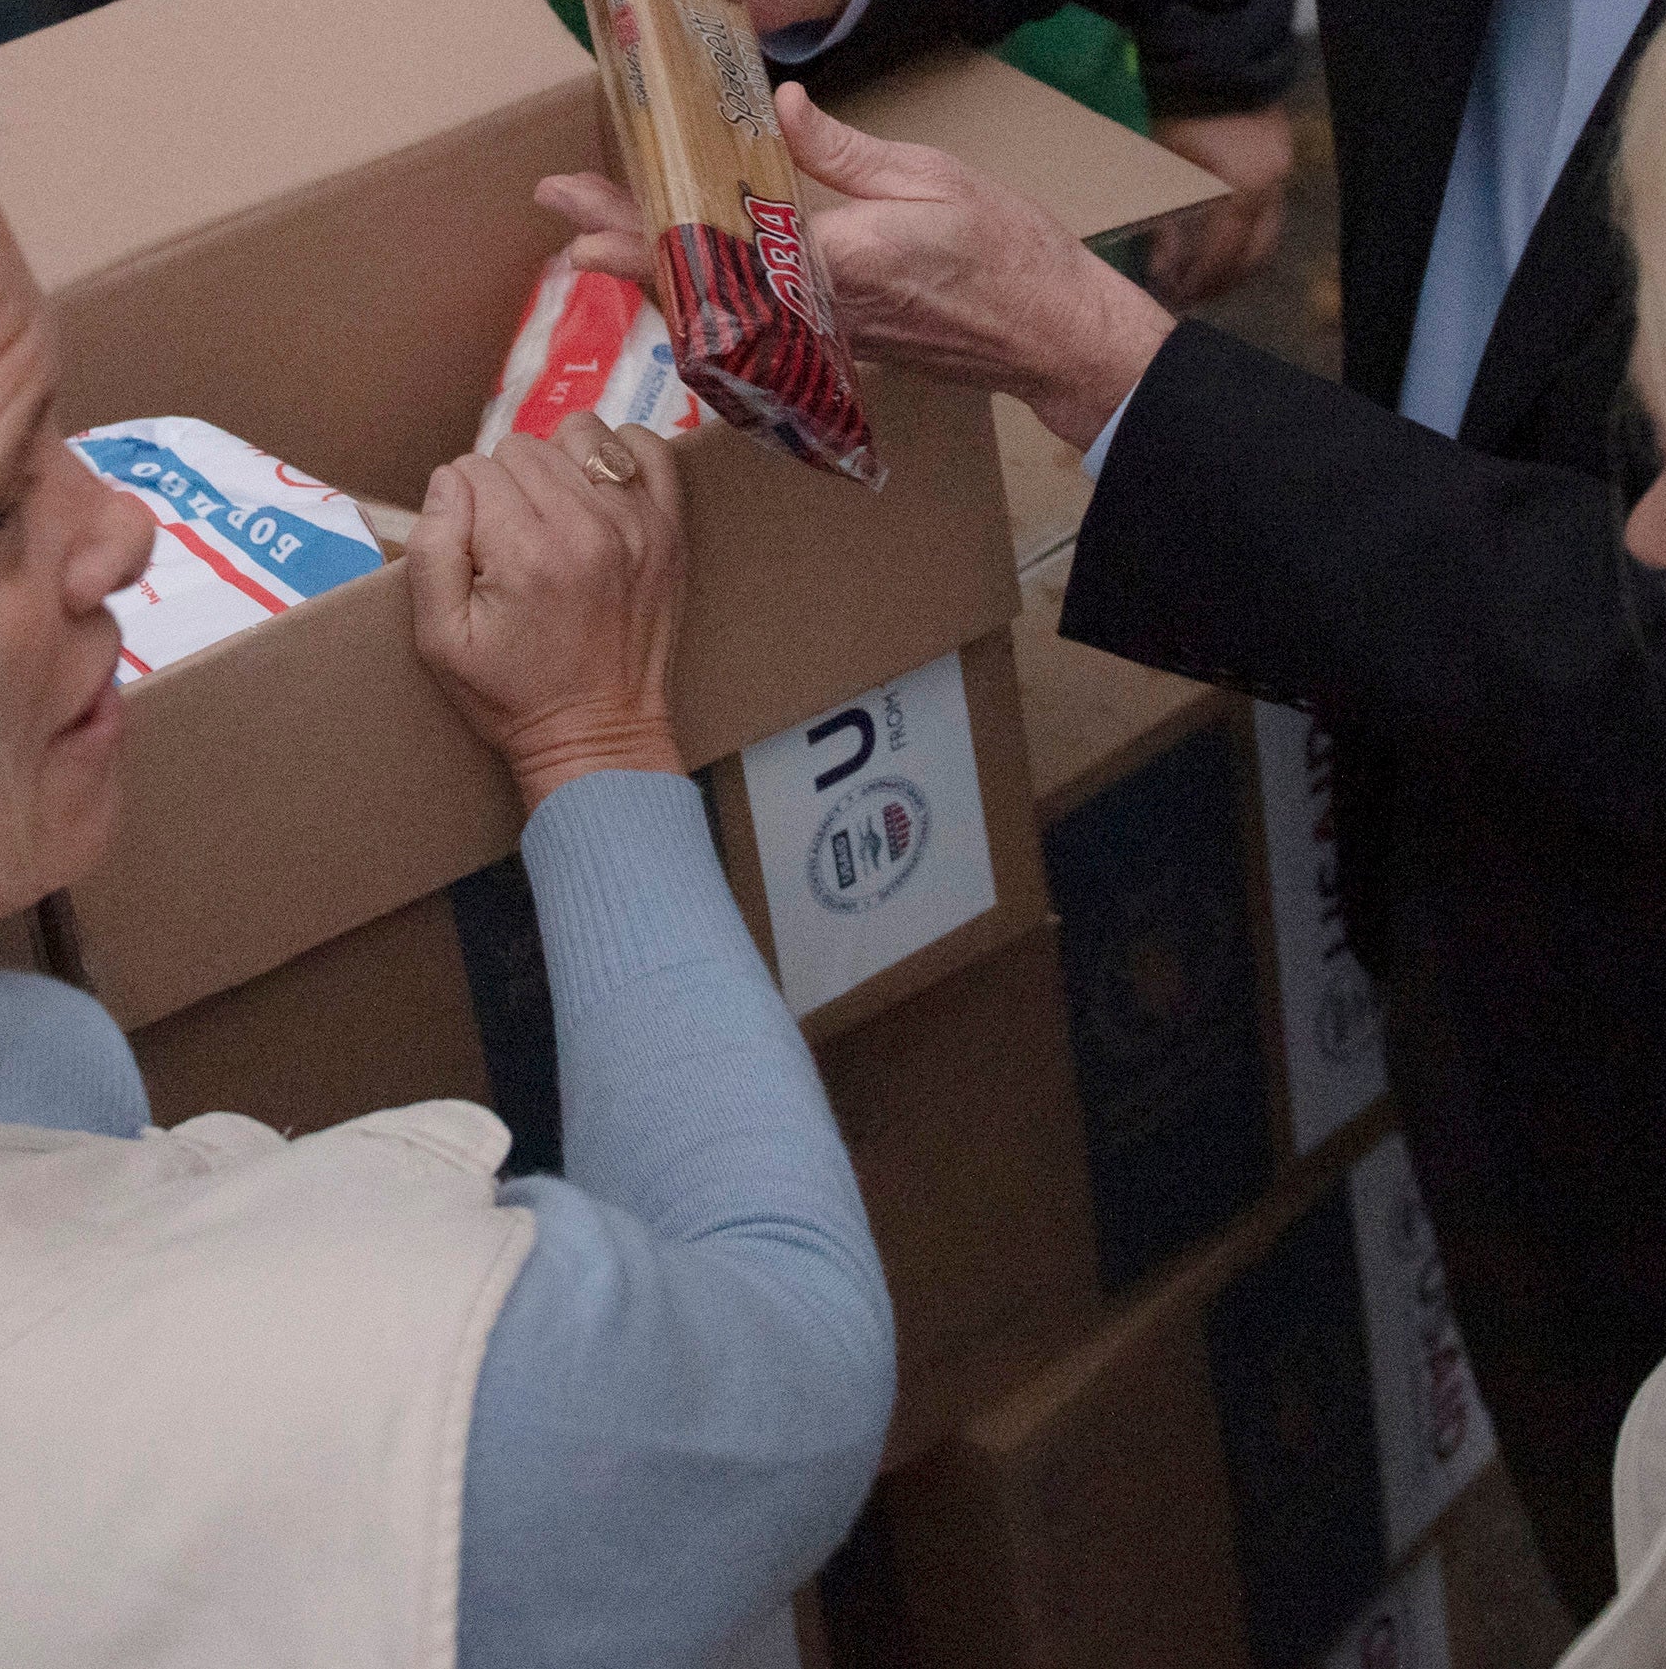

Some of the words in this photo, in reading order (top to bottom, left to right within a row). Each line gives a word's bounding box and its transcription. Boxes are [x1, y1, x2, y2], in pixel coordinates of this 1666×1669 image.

[681, 4, 763, 139] Spagetti
[563, 358, 599, 373] 1
[883, 689, 910, 752] FROM
